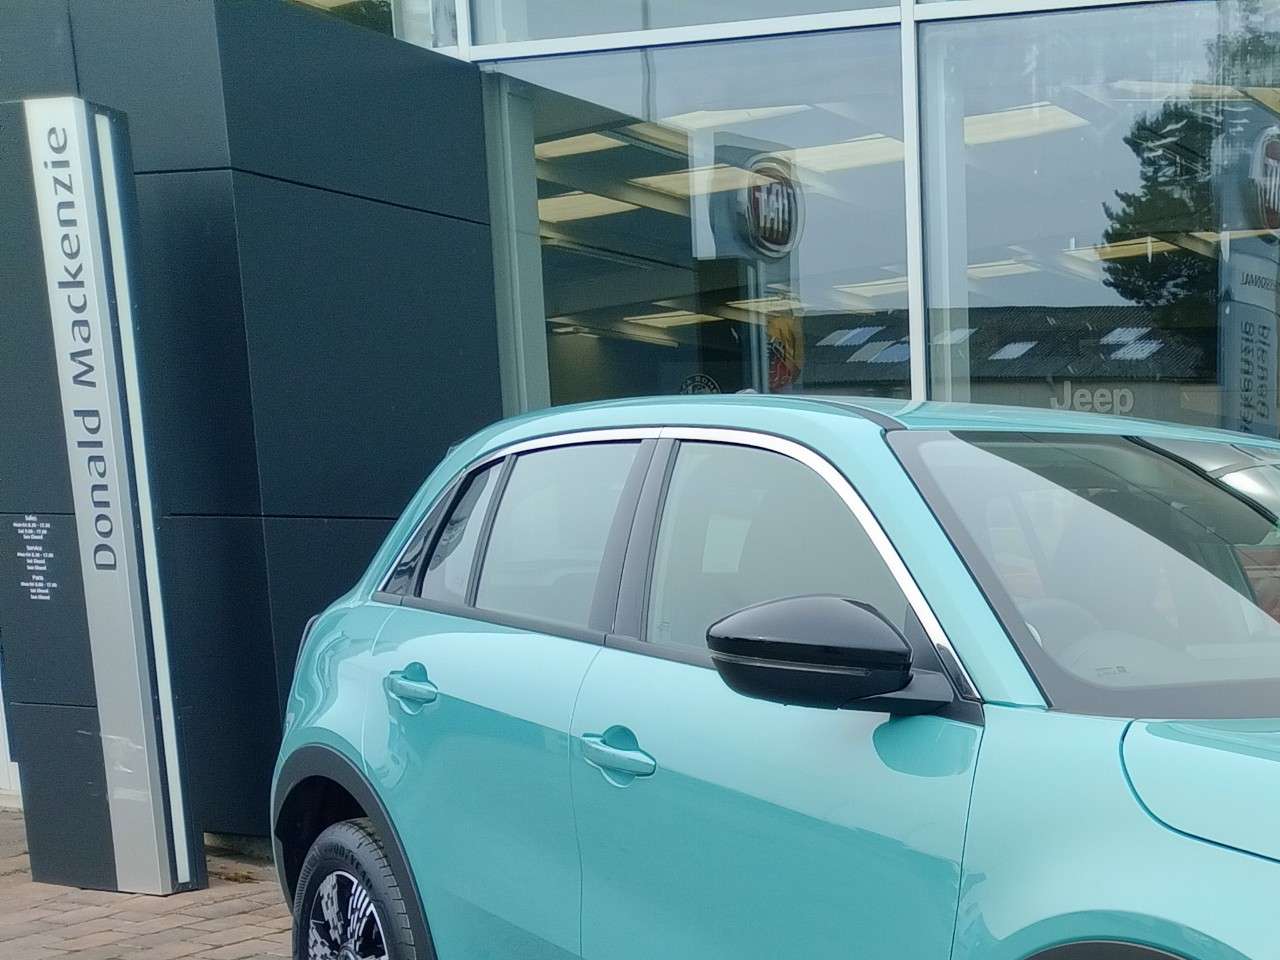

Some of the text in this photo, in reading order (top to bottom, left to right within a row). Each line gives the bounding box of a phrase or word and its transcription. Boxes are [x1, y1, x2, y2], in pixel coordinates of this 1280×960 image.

[44, 126, 117, 571] Donald Mackenzie
[1049, 380, 1134, 416] Jeep
